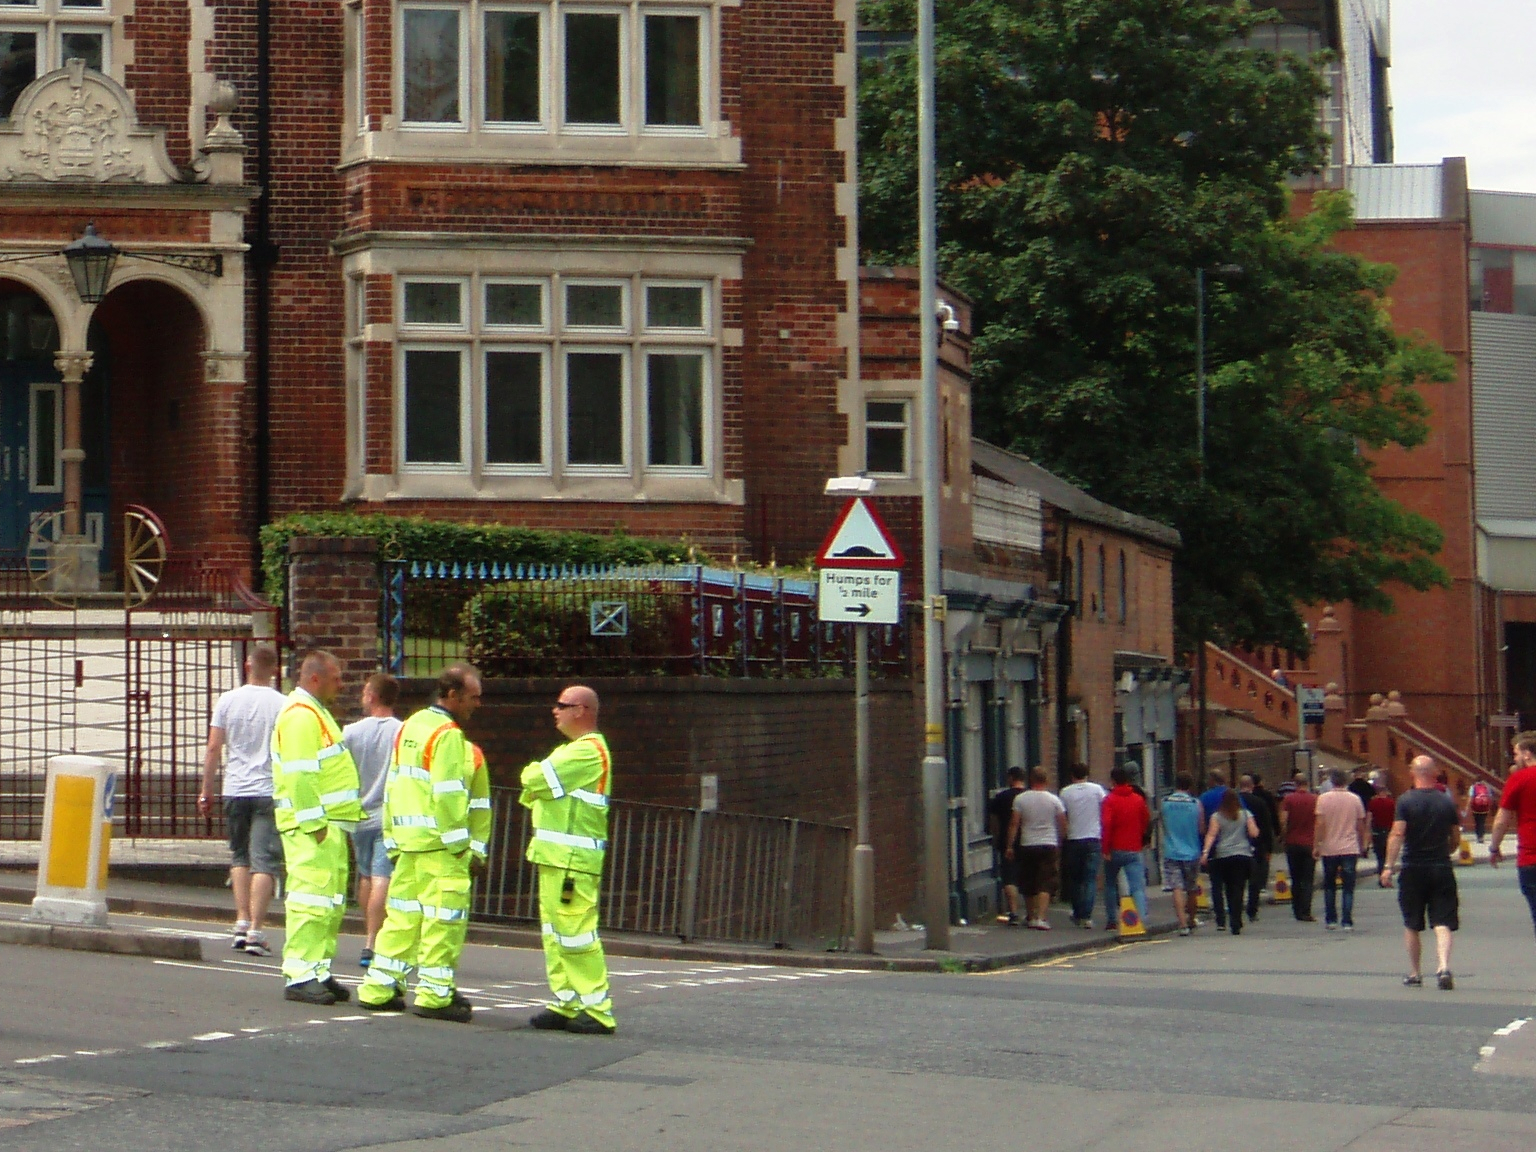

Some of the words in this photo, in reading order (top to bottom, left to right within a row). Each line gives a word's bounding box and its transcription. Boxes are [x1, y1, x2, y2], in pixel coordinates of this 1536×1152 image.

[826, 573, 871, 586] Humps
[874, 575, 892, 586] for
[851, 588, 879, 598] mile
